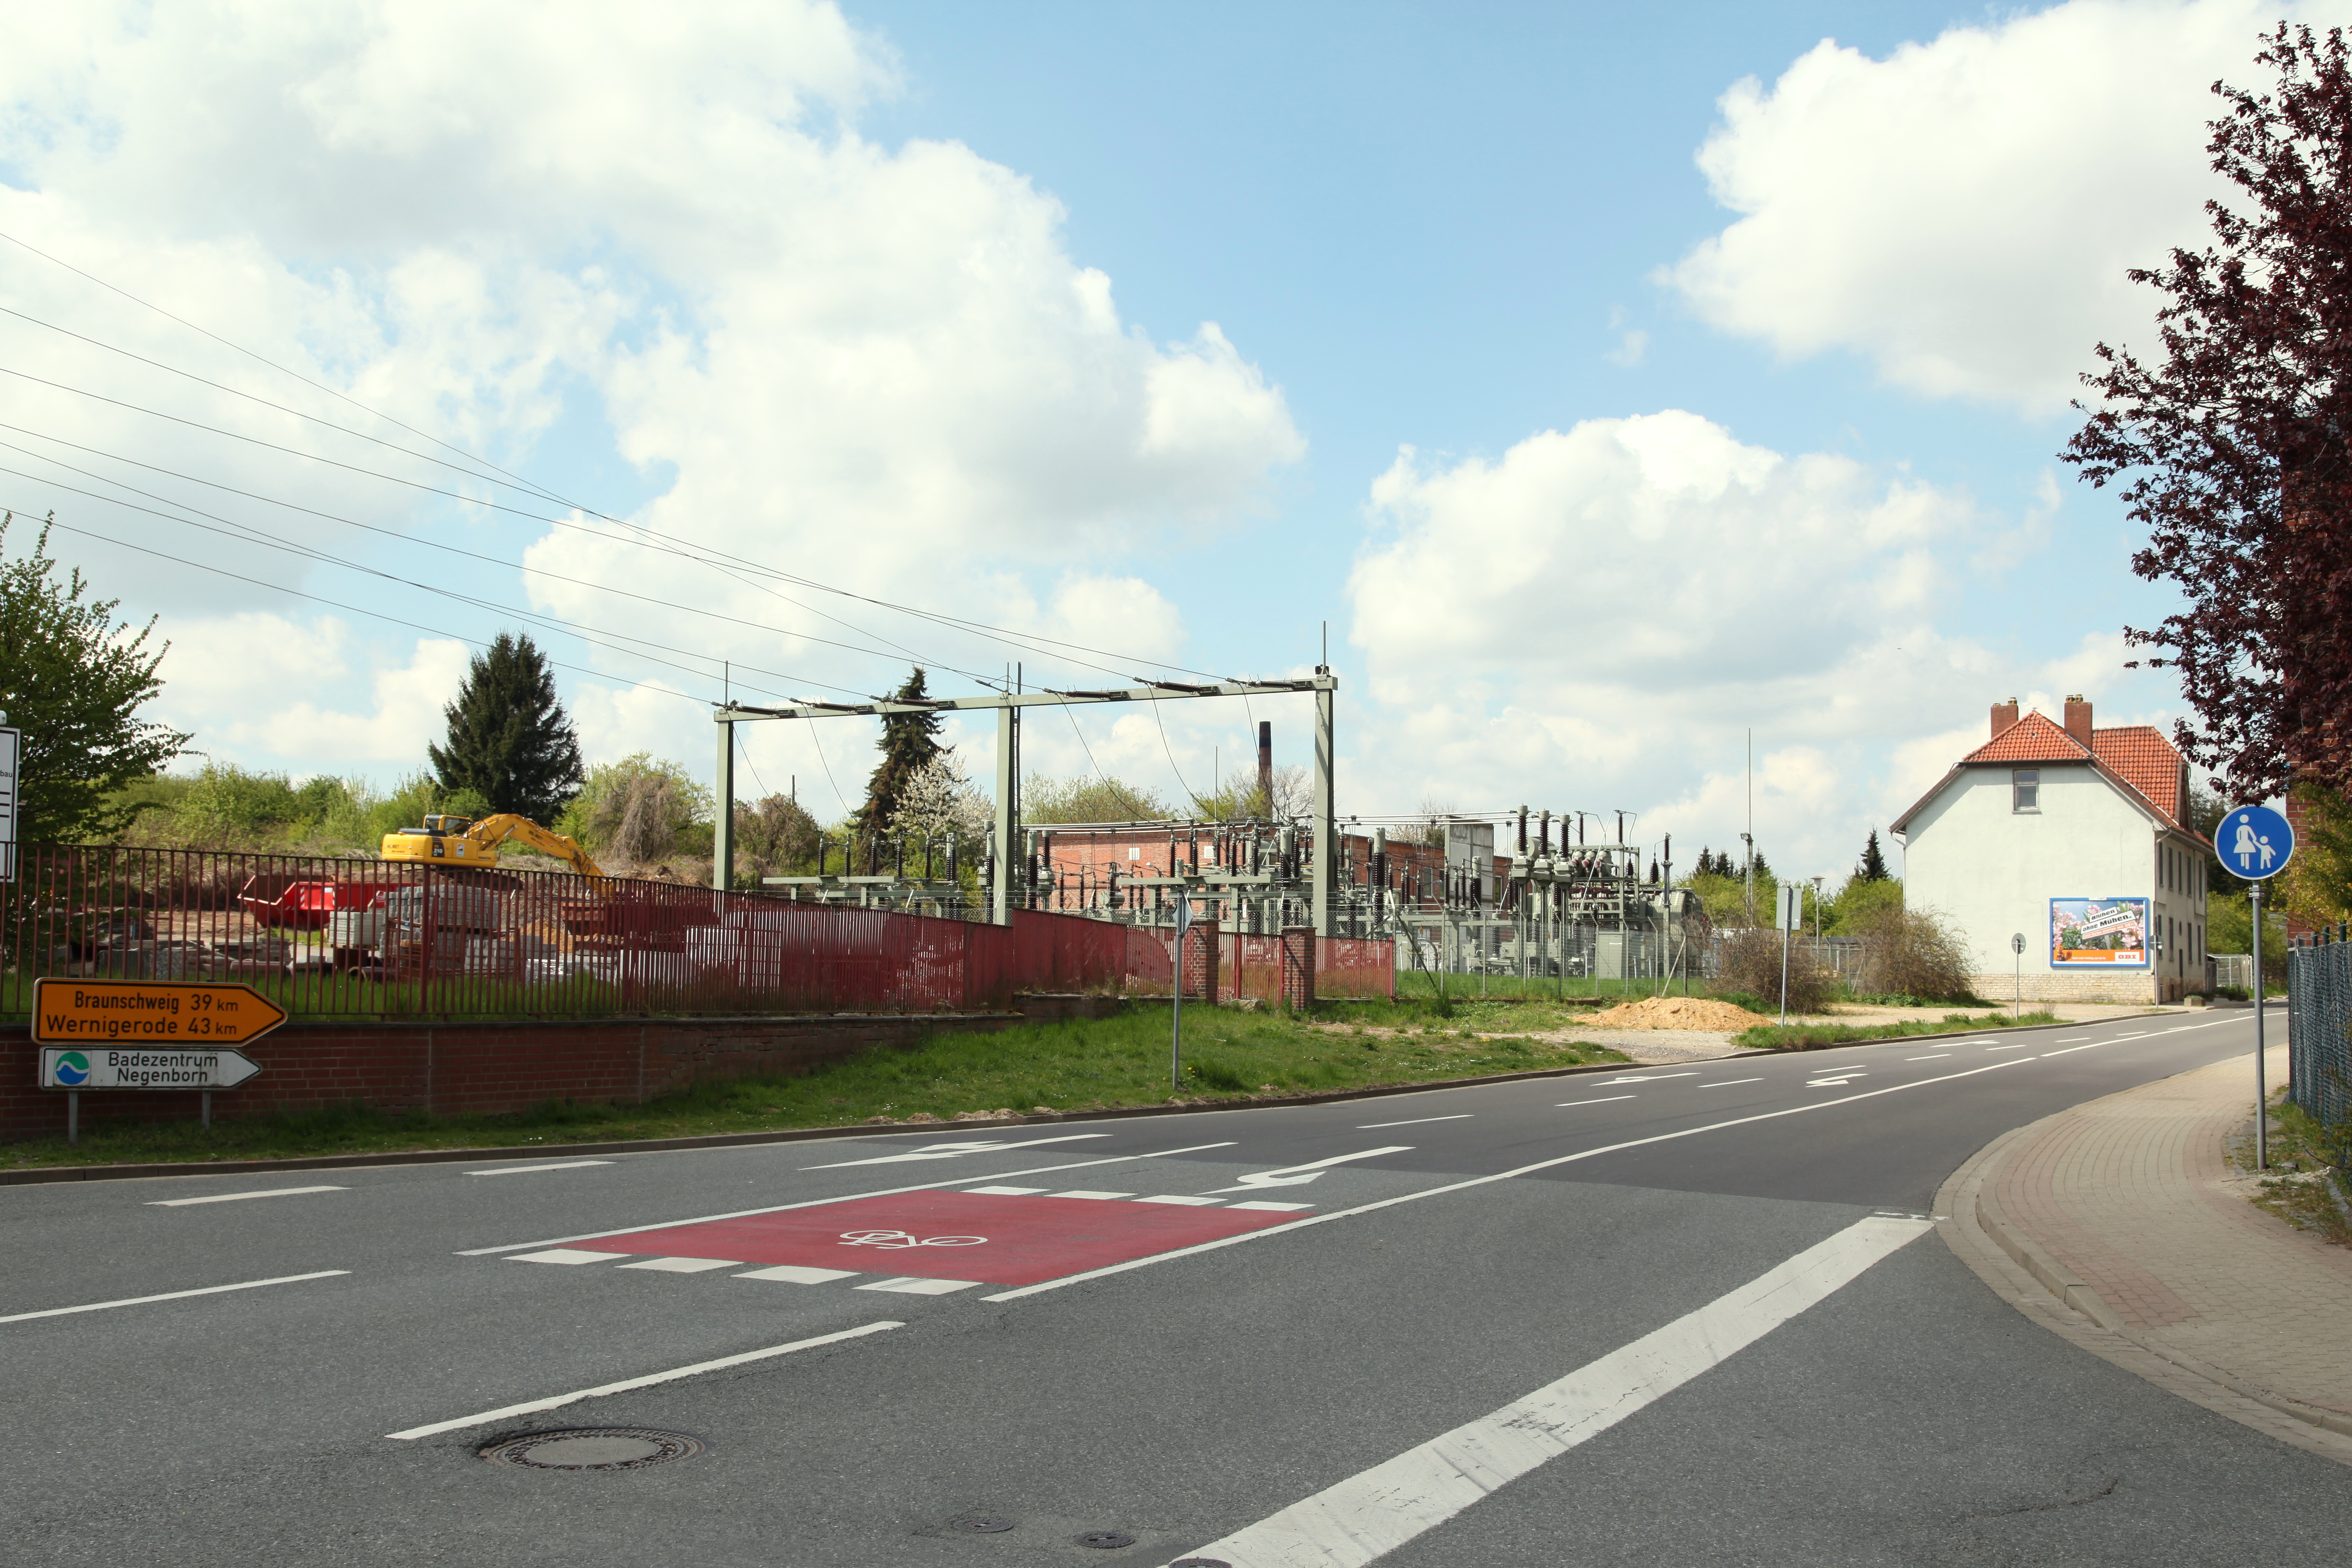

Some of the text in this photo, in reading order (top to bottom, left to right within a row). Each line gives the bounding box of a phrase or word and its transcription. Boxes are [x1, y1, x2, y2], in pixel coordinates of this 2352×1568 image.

[2083, 914, 2132, 932] ohne Mühen.
[2091, 909, 2115, 921] Blühen
[74, 990, 238, 1015] Braunschweig 39 km
[46, 1014, 237, 1038] Wernigerode 43 km
[108, 1051, 218, 1067] Badezentrum
[117, 1067, 208, 1086] Negenborn
